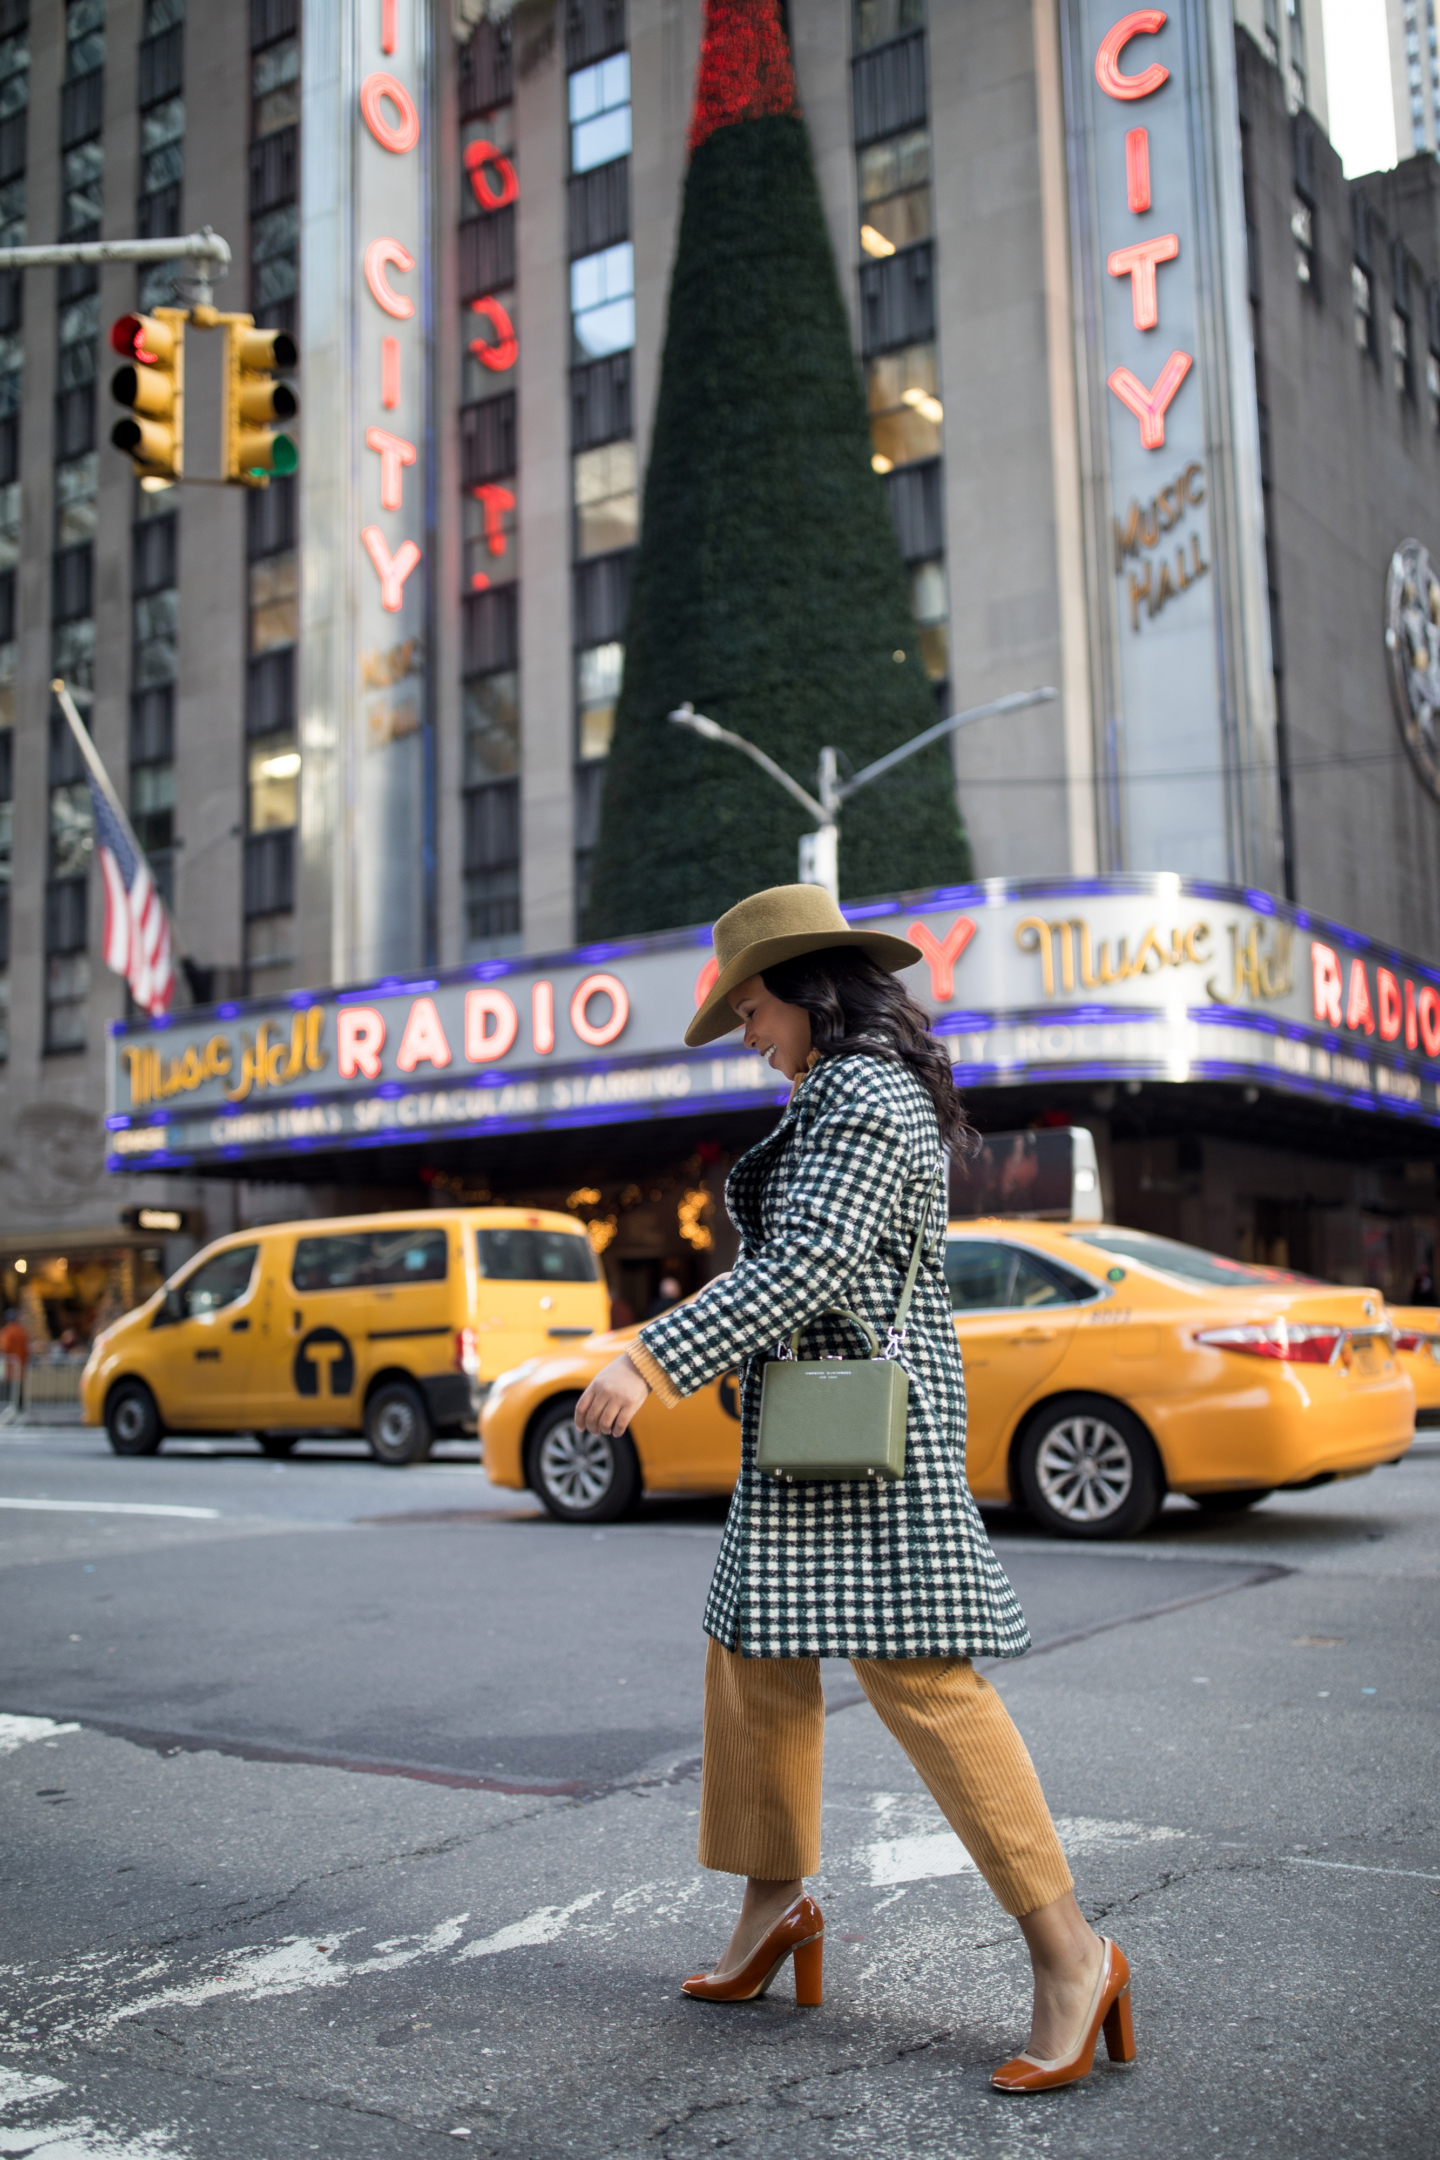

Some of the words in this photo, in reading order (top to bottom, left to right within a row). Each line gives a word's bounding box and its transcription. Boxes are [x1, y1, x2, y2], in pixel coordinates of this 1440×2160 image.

[1094, 8, 1193, 450] CITY
[363, 236, 421, 612] CITY
[1112, 461, 1205, 575] MUSIC
[1127, 531, 1210, 634] HALL
[1014, 914, 1212, 998] Music
[1311, 941, 1440, 1058] RADIO
[336, 972, 630, 1080] RADIO
[352, 1080, 540, 1133] SPCTACULAR
[551, 1062, 692, 1111] STARRING
